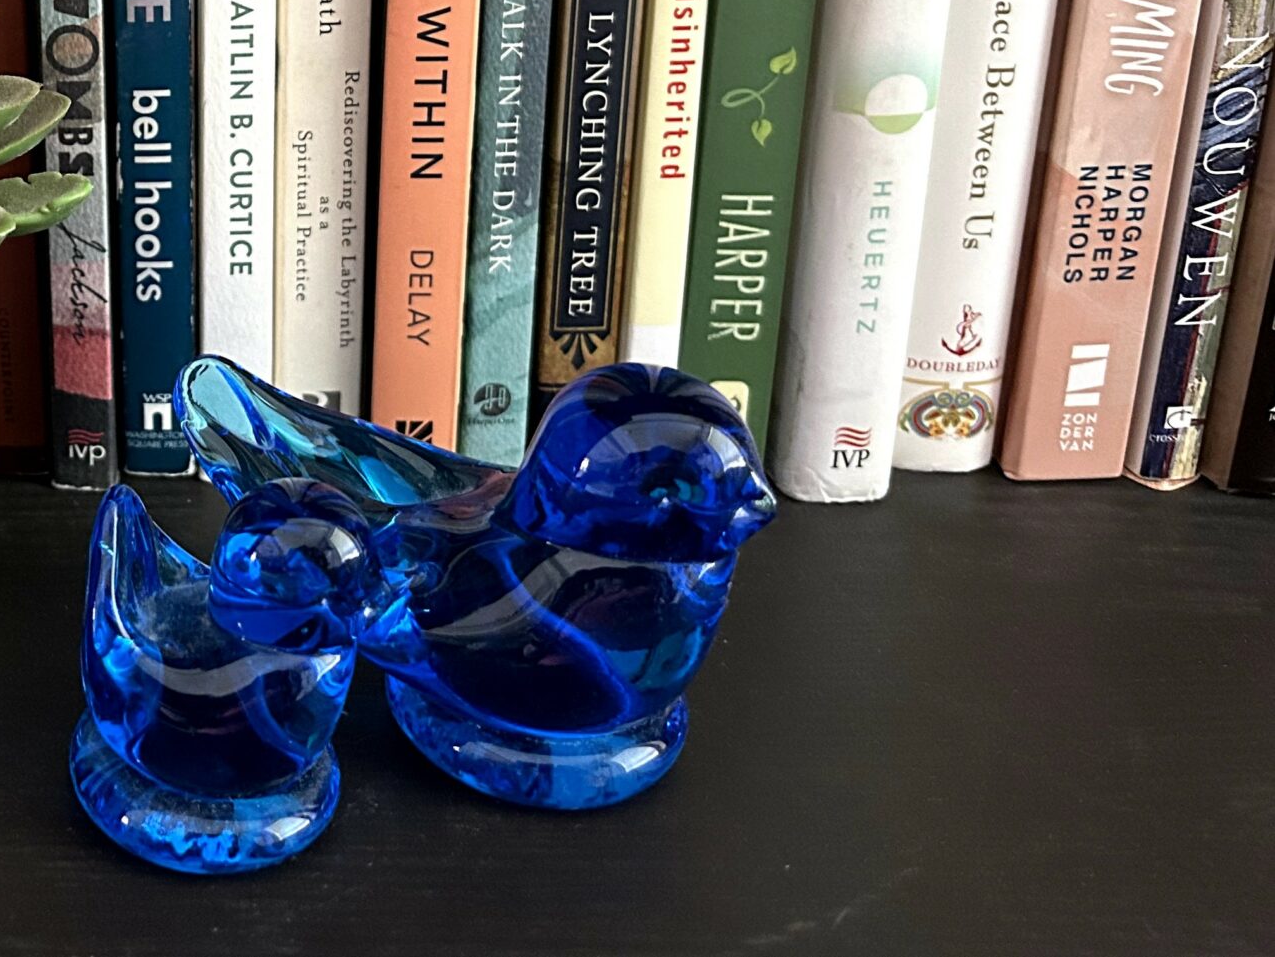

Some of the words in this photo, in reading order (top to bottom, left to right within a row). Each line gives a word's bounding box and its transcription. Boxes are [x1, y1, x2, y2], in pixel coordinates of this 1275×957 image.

[132, 88, 172, 165] bell
[230, 115, 253, 140] B.
[409, 7, 453, 180] WITHIN
[498, 73, 522, 108] IN
[574, 12, 614, 214] LYNCHING
[968, 63, 1014, 201] Between
[293, 130, 313, 218] Spiritual
[337, 71, 360, 209] Rediscovering
[494, 115, 520, 179] THE
[1174, 34, 1270, 329] NOUWEN
[134, 181, 173, 302] hooks
[227, 149, 255, 277] CURTICE
[320, 197, 329, 214] as
[320, 222, 328, 230] a
[341, 216, 357, 247] the
[488, 188, 517, 274] DARK
[962, 212, 995, 250] Us
[1063, 166, 1099, 283] NICHOLS
[1090, 165, 1126, 283] HARPER
[1116, 164, 1153, 281] MORGAN
[296, 228, 311, 302] Practice
[407, 251, 433, 347] DELAY
[568, 227, 599, 318] TREE
[709, 193, 774, 341] HARPER
[856, 179, 893, 335] HEUERTZ
[336, 256, 357, 348] Labyrinth
[831, 449, 870, 469] IVP
[1059, 427, 1096, 439] DER
[1059, 440, 1094, 453] VAN
[1061, 413, 1099, 426] ZON
